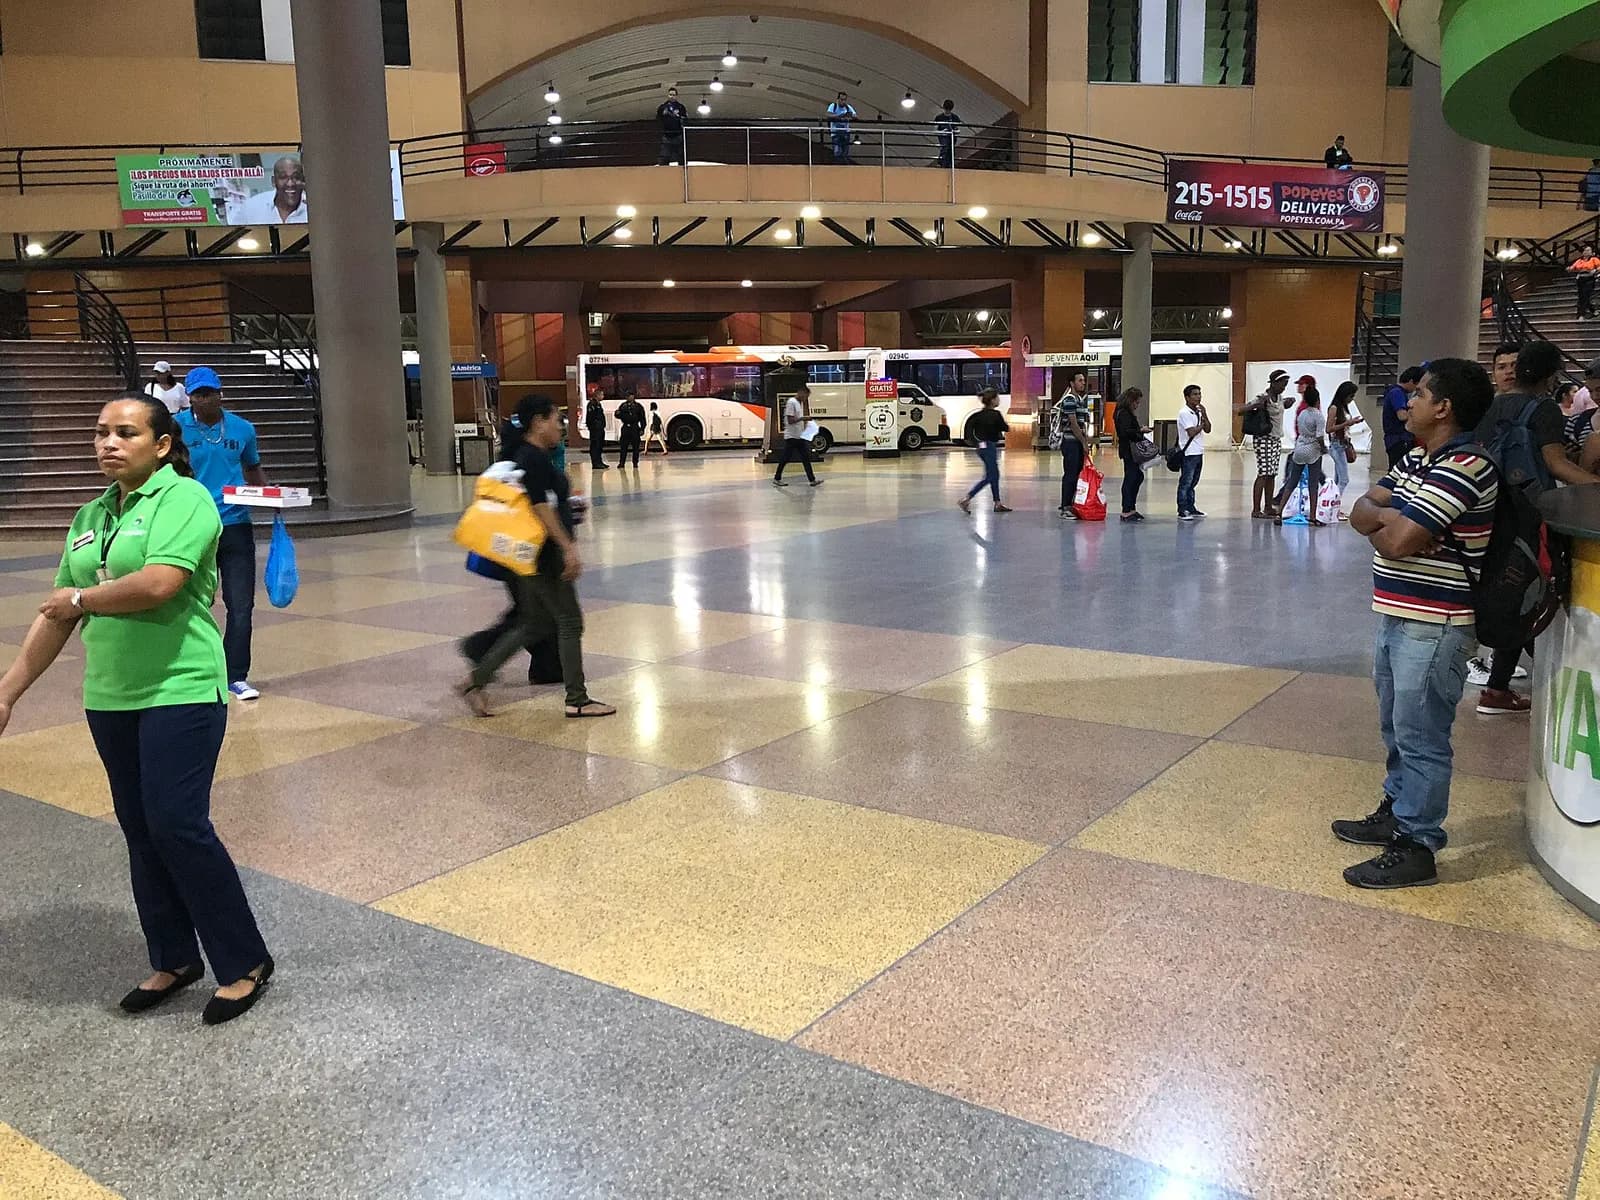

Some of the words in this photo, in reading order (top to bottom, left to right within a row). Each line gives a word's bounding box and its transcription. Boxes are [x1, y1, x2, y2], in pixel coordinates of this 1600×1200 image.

[148, 169, 179, 179] PRECIOS
[180, 168, 196, 179] MÁS
[197, 168, 220, 178] BAJOS
[133, 191, 156, 200] Pasillo
[158, 191, 166, 199] de
[168, 191, 175, 199] la
[1174, 181, 1272, 210] 215-1515
[1281, 200, 1346, 216] DELIVERY
[1280, 215, 1345, 226] POPEYES.COM.PA
[888, 352, 909, 360] 0294C
[1045, 354, 1055, 362] DE
[1056, 354, 1079, 362] VENTA
[1080, 352, 1099, 362] AQUÍ
[223, 440, 240, 450] FBI
